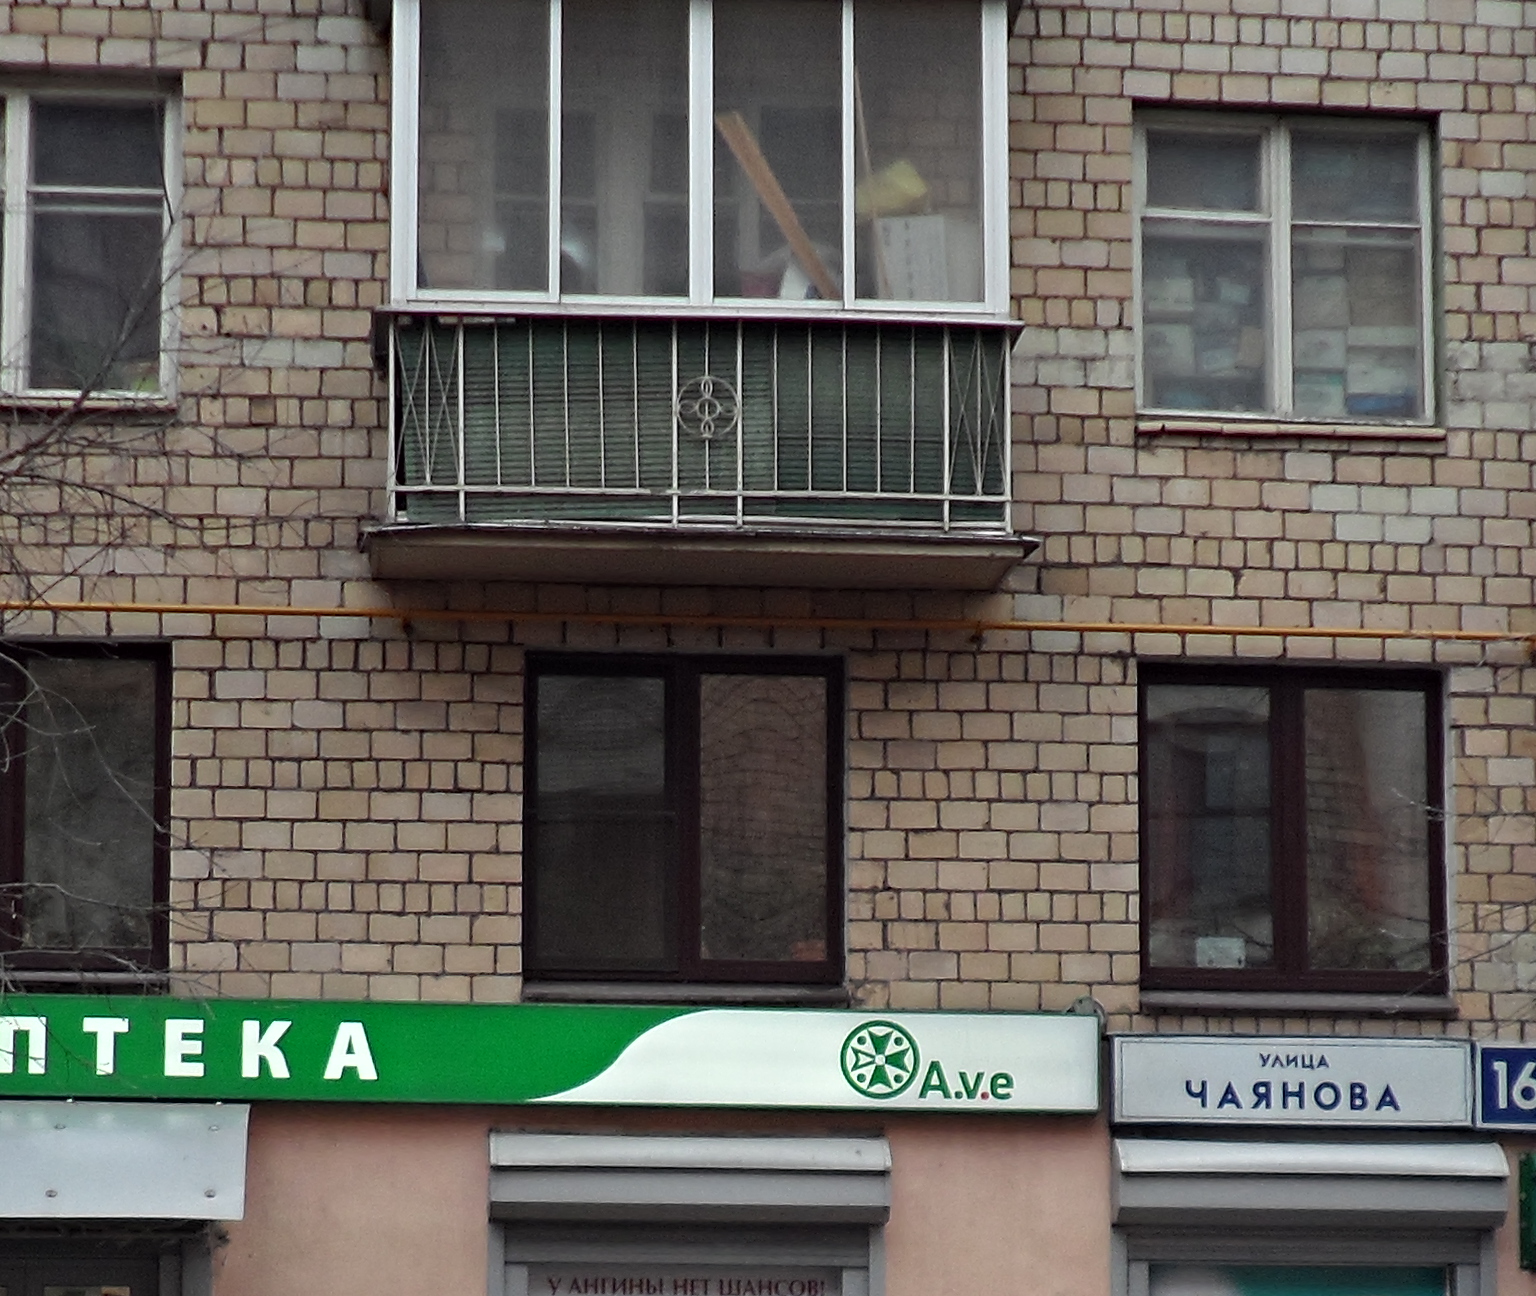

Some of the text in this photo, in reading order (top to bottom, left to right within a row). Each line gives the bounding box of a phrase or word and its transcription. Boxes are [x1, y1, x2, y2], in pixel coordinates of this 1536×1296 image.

[1258, 1052, 1331, 1070] УЛИЦА
[918, 1058, 1015, 1101] A.v.e
[1183, 1078, 1402, 1113] ЧАЯНОВА
[546, 1277, 562, 1296] У
[568, 1277, 664, 1296] АНГИНЫ
[672, 1278, 711, 1296] НЕТ
